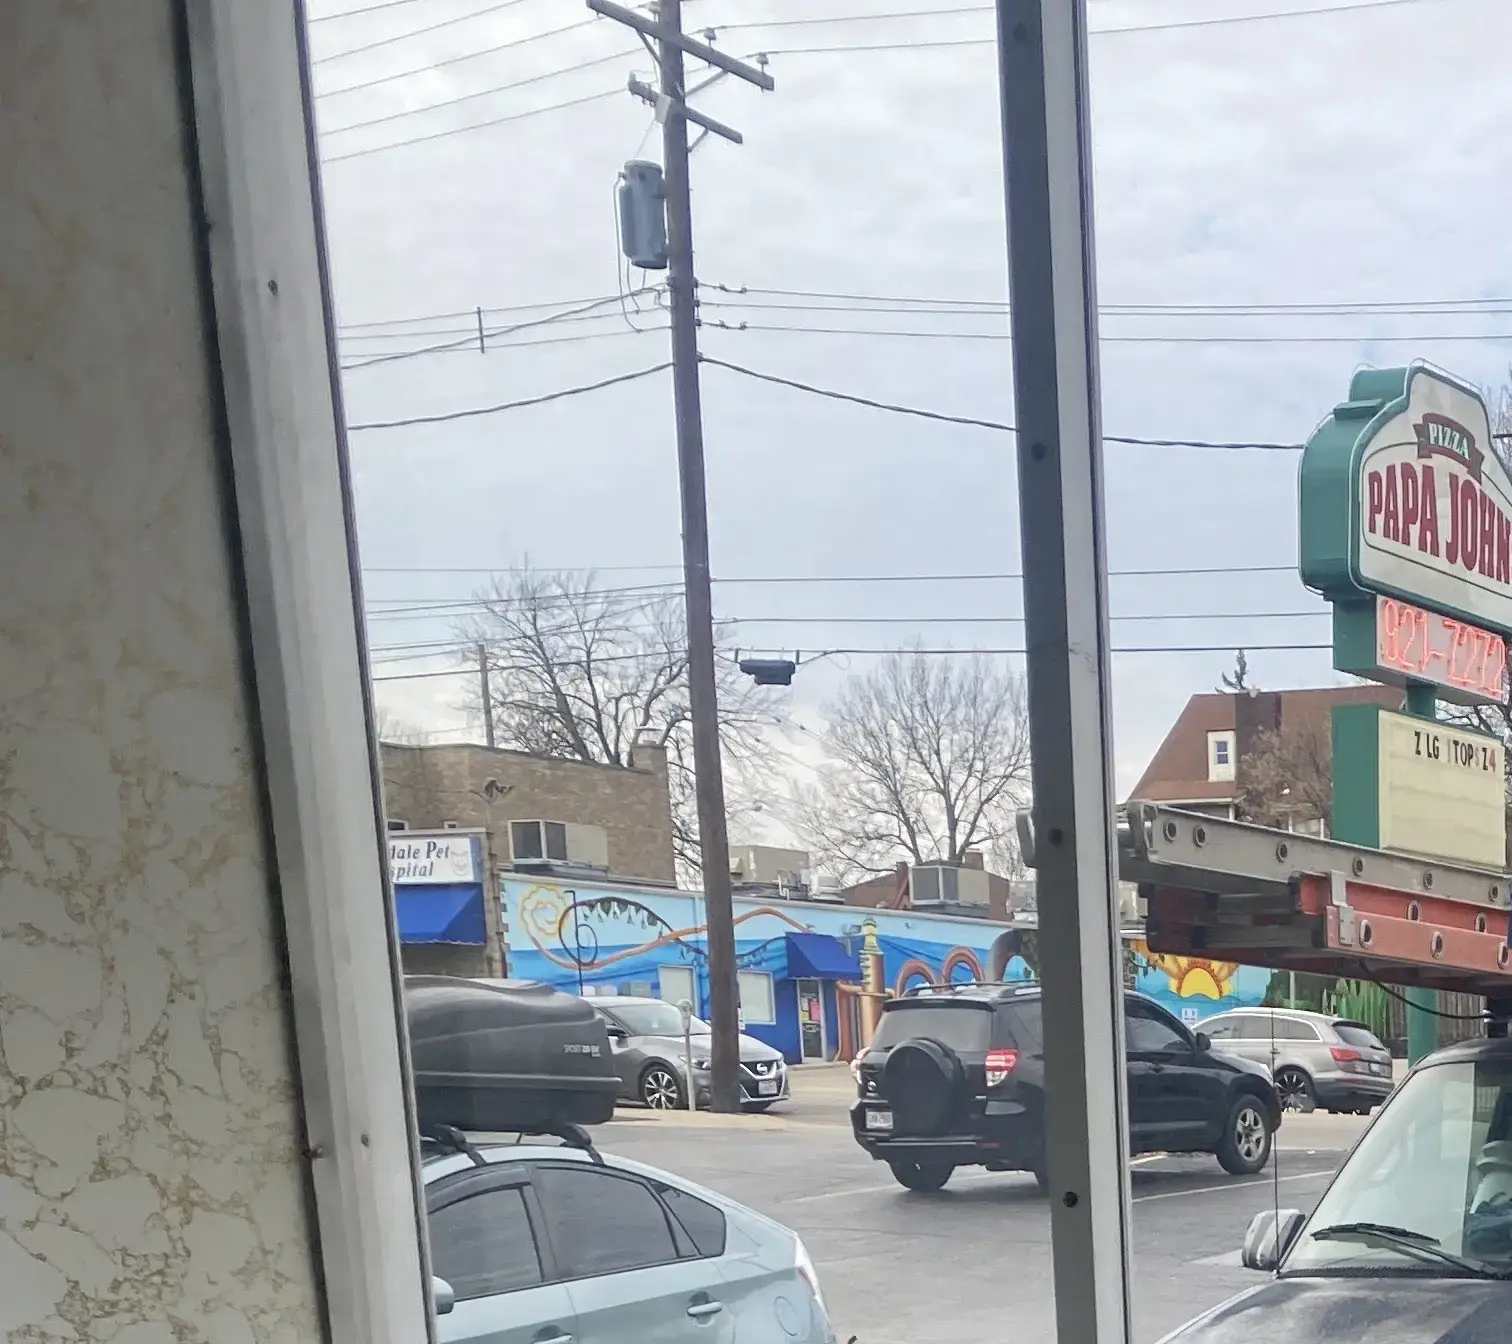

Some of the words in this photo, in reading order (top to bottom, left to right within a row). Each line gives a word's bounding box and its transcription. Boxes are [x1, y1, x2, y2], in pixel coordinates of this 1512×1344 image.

[1428, 422, 1470, 461] PIZZA
[1368, 462, 1440, 558] PAPA
[1426, 733, 1440, 760] LG
[425, 841, 450, 859] Pet
